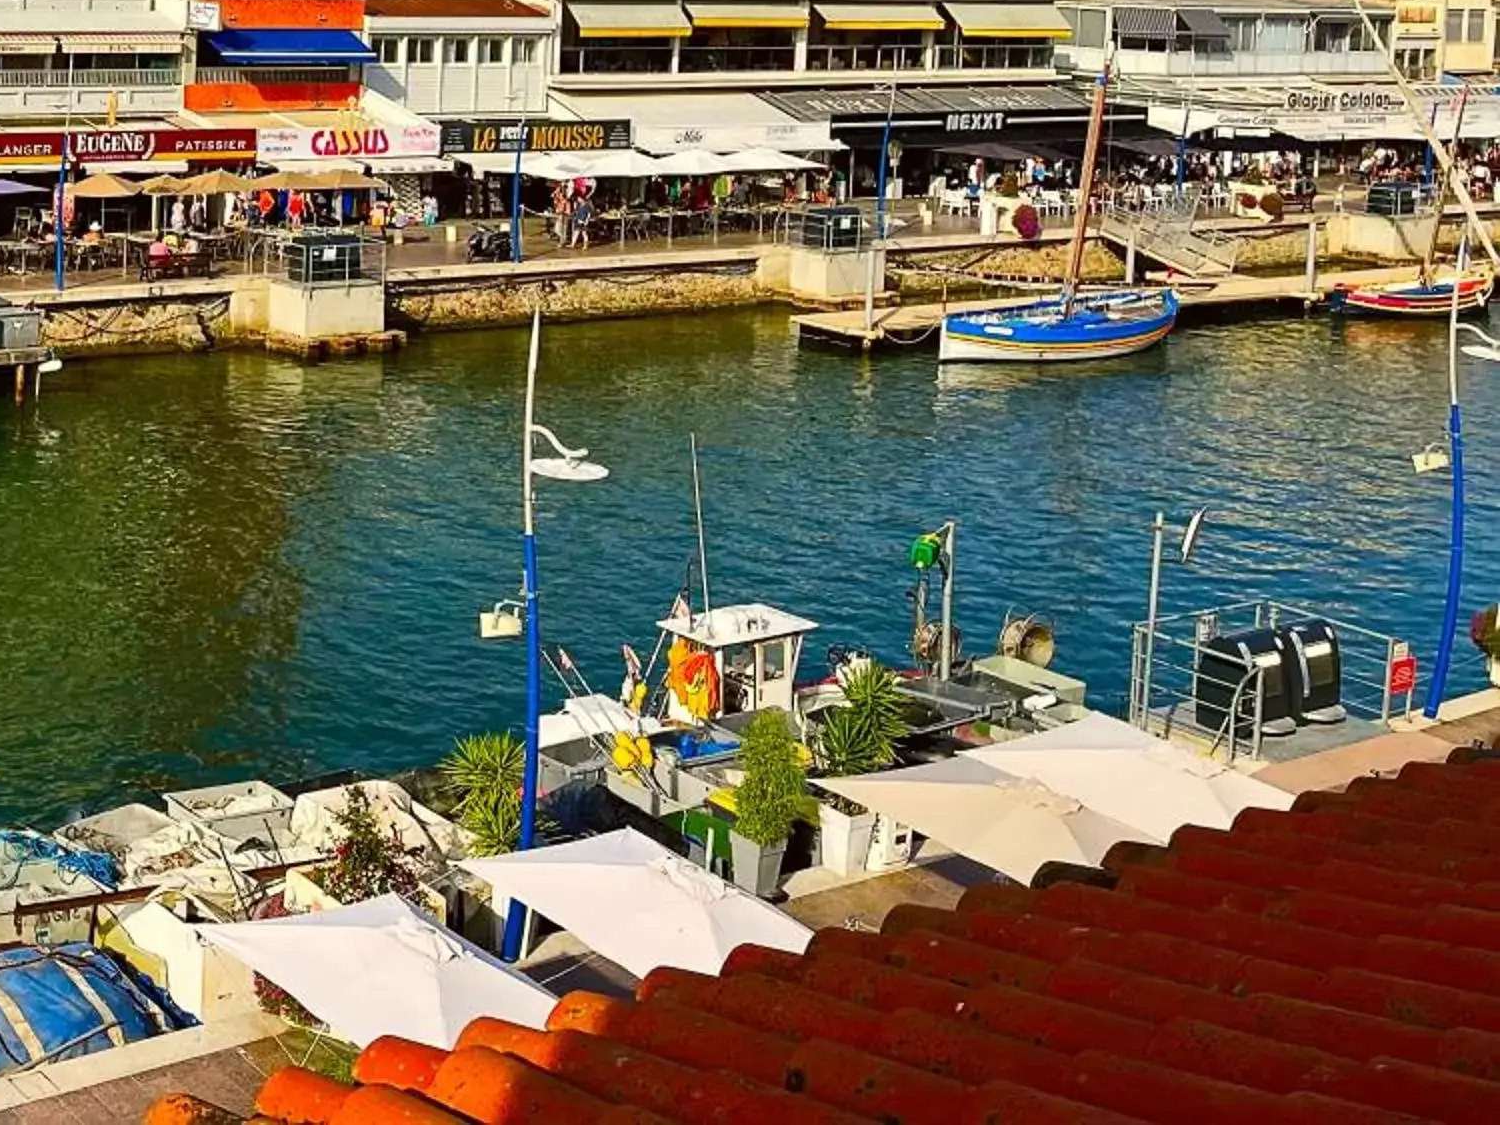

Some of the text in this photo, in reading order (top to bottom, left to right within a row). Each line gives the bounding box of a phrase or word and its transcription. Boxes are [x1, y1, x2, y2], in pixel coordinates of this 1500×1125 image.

[1288, 92, 1336, 108] Glacier
[946, 113, 1004, 132] NEXXT
[175, 140, 247, 152] PATISSIER
[311, 129, 389, 156] CASSUS
